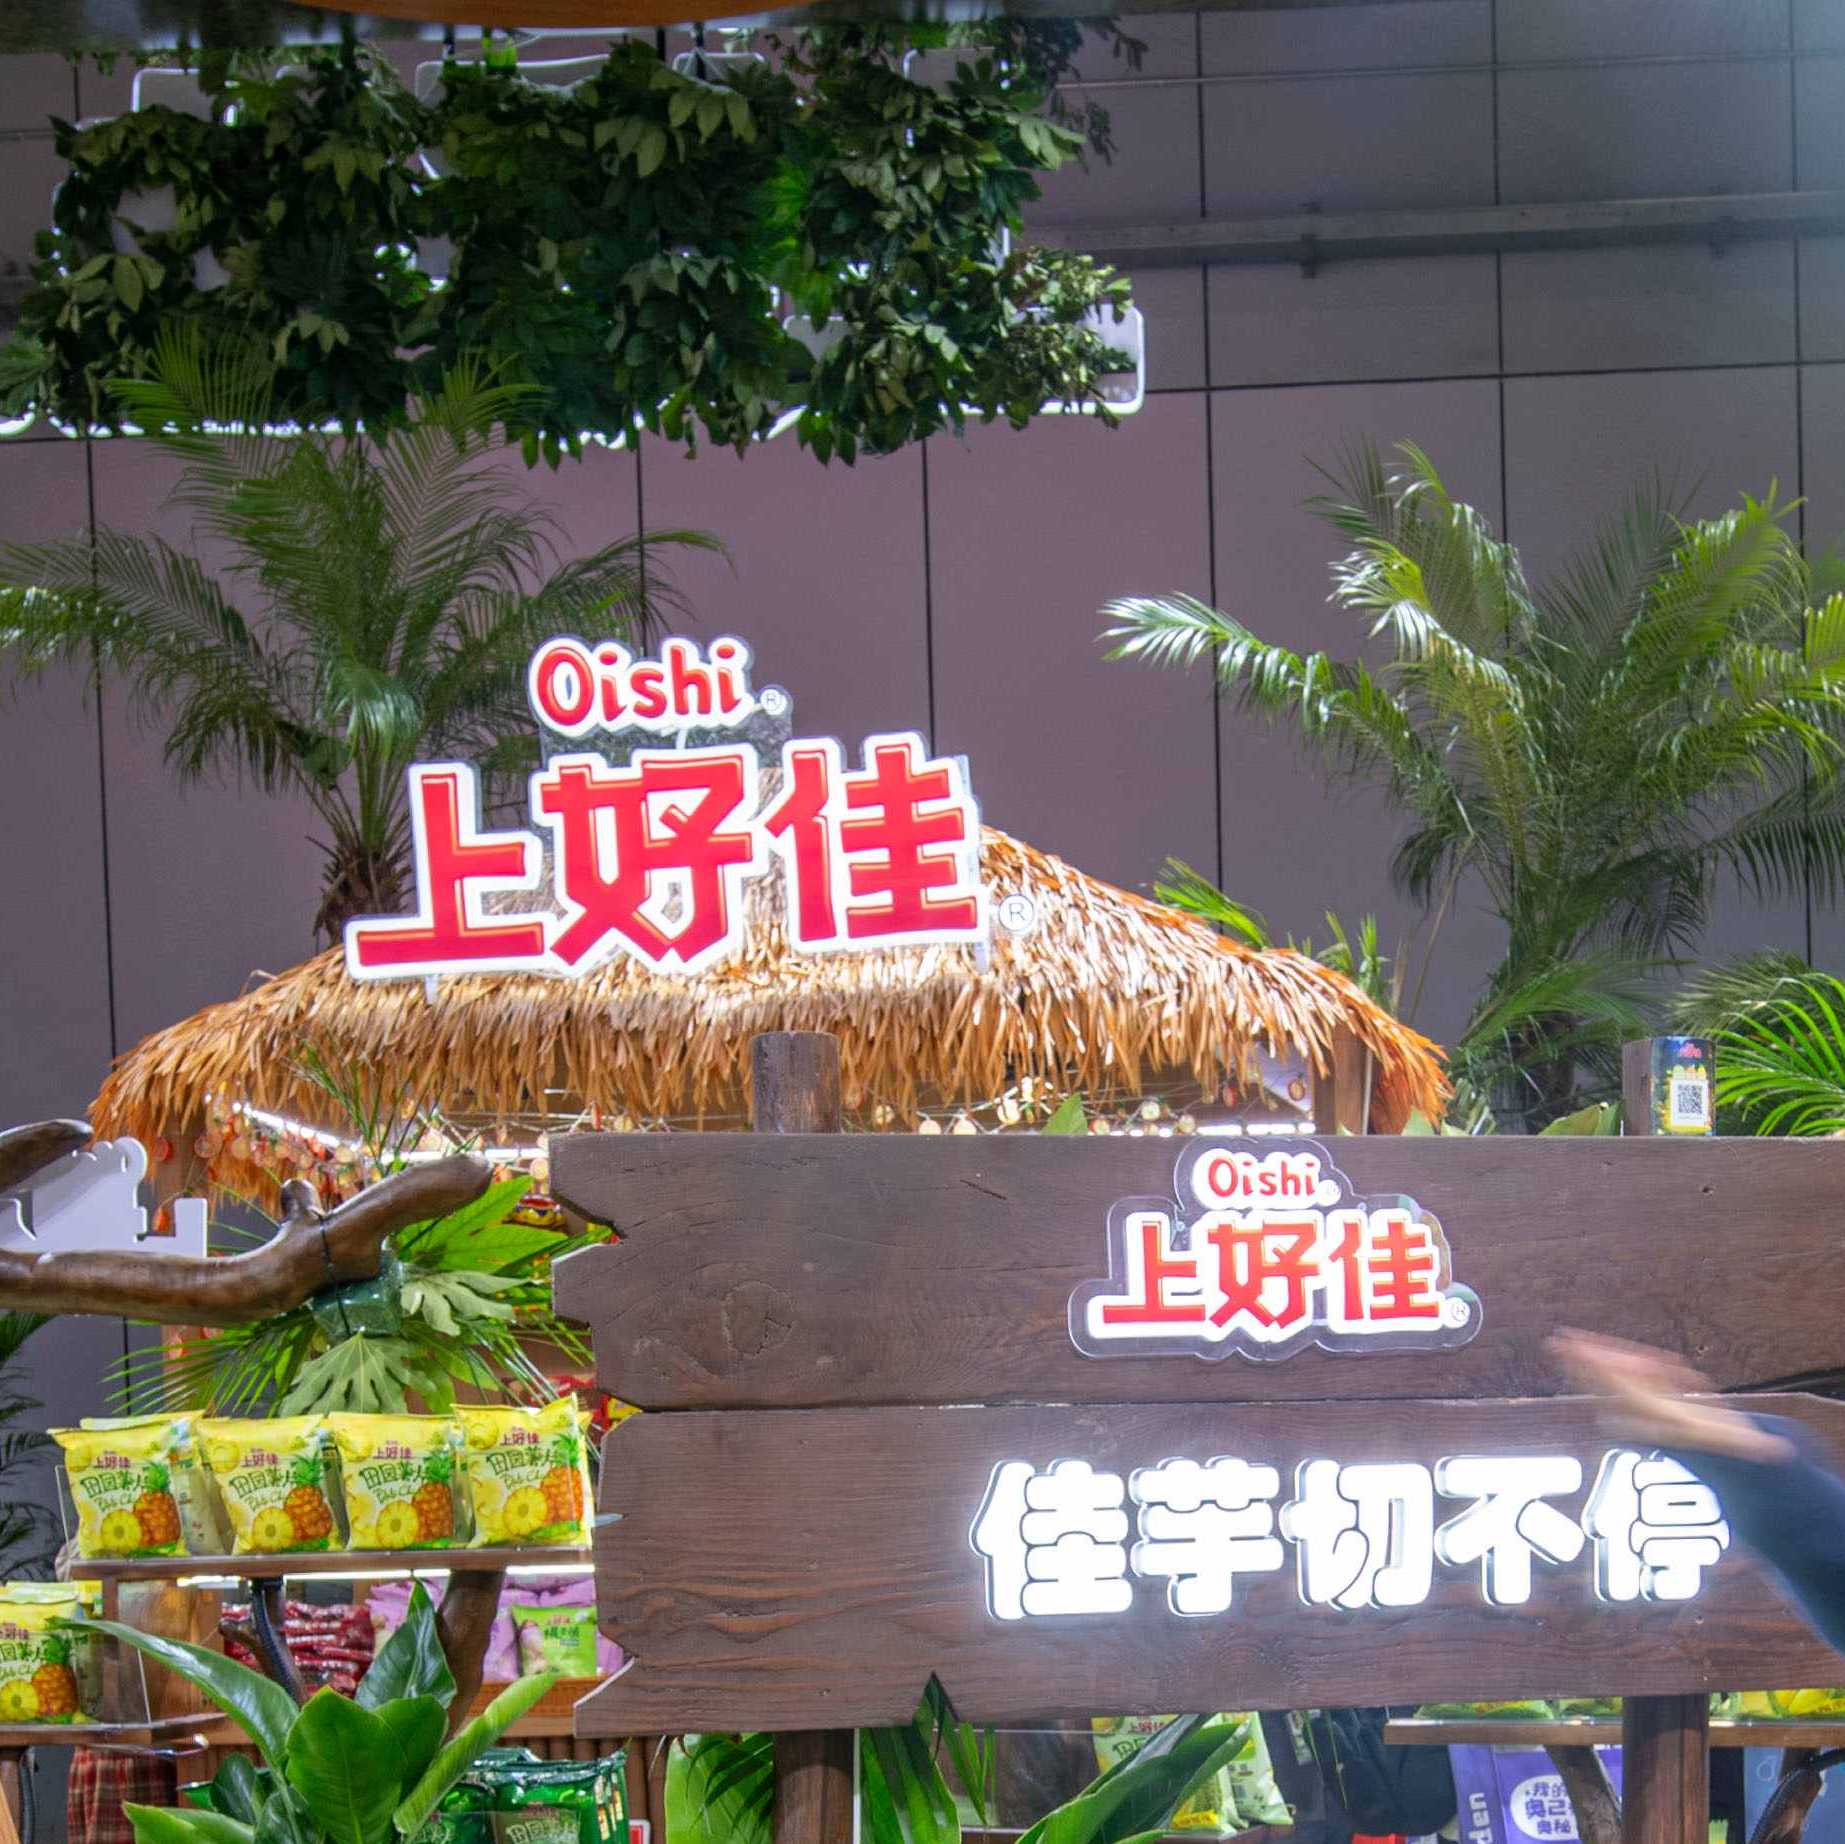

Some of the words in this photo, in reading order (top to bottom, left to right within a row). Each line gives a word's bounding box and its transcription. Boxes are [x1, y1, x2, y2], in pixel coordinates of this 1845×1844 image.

[536, 643, 741, 727] Oishi
[357, 743, 978, 966] 上好佳
[1208, 1157, 1320, 1198] Oishi
[1103, 1220, 1440, 1329] 上好佳
[968, 1447, 1731, 1620] 佳芋切不停
